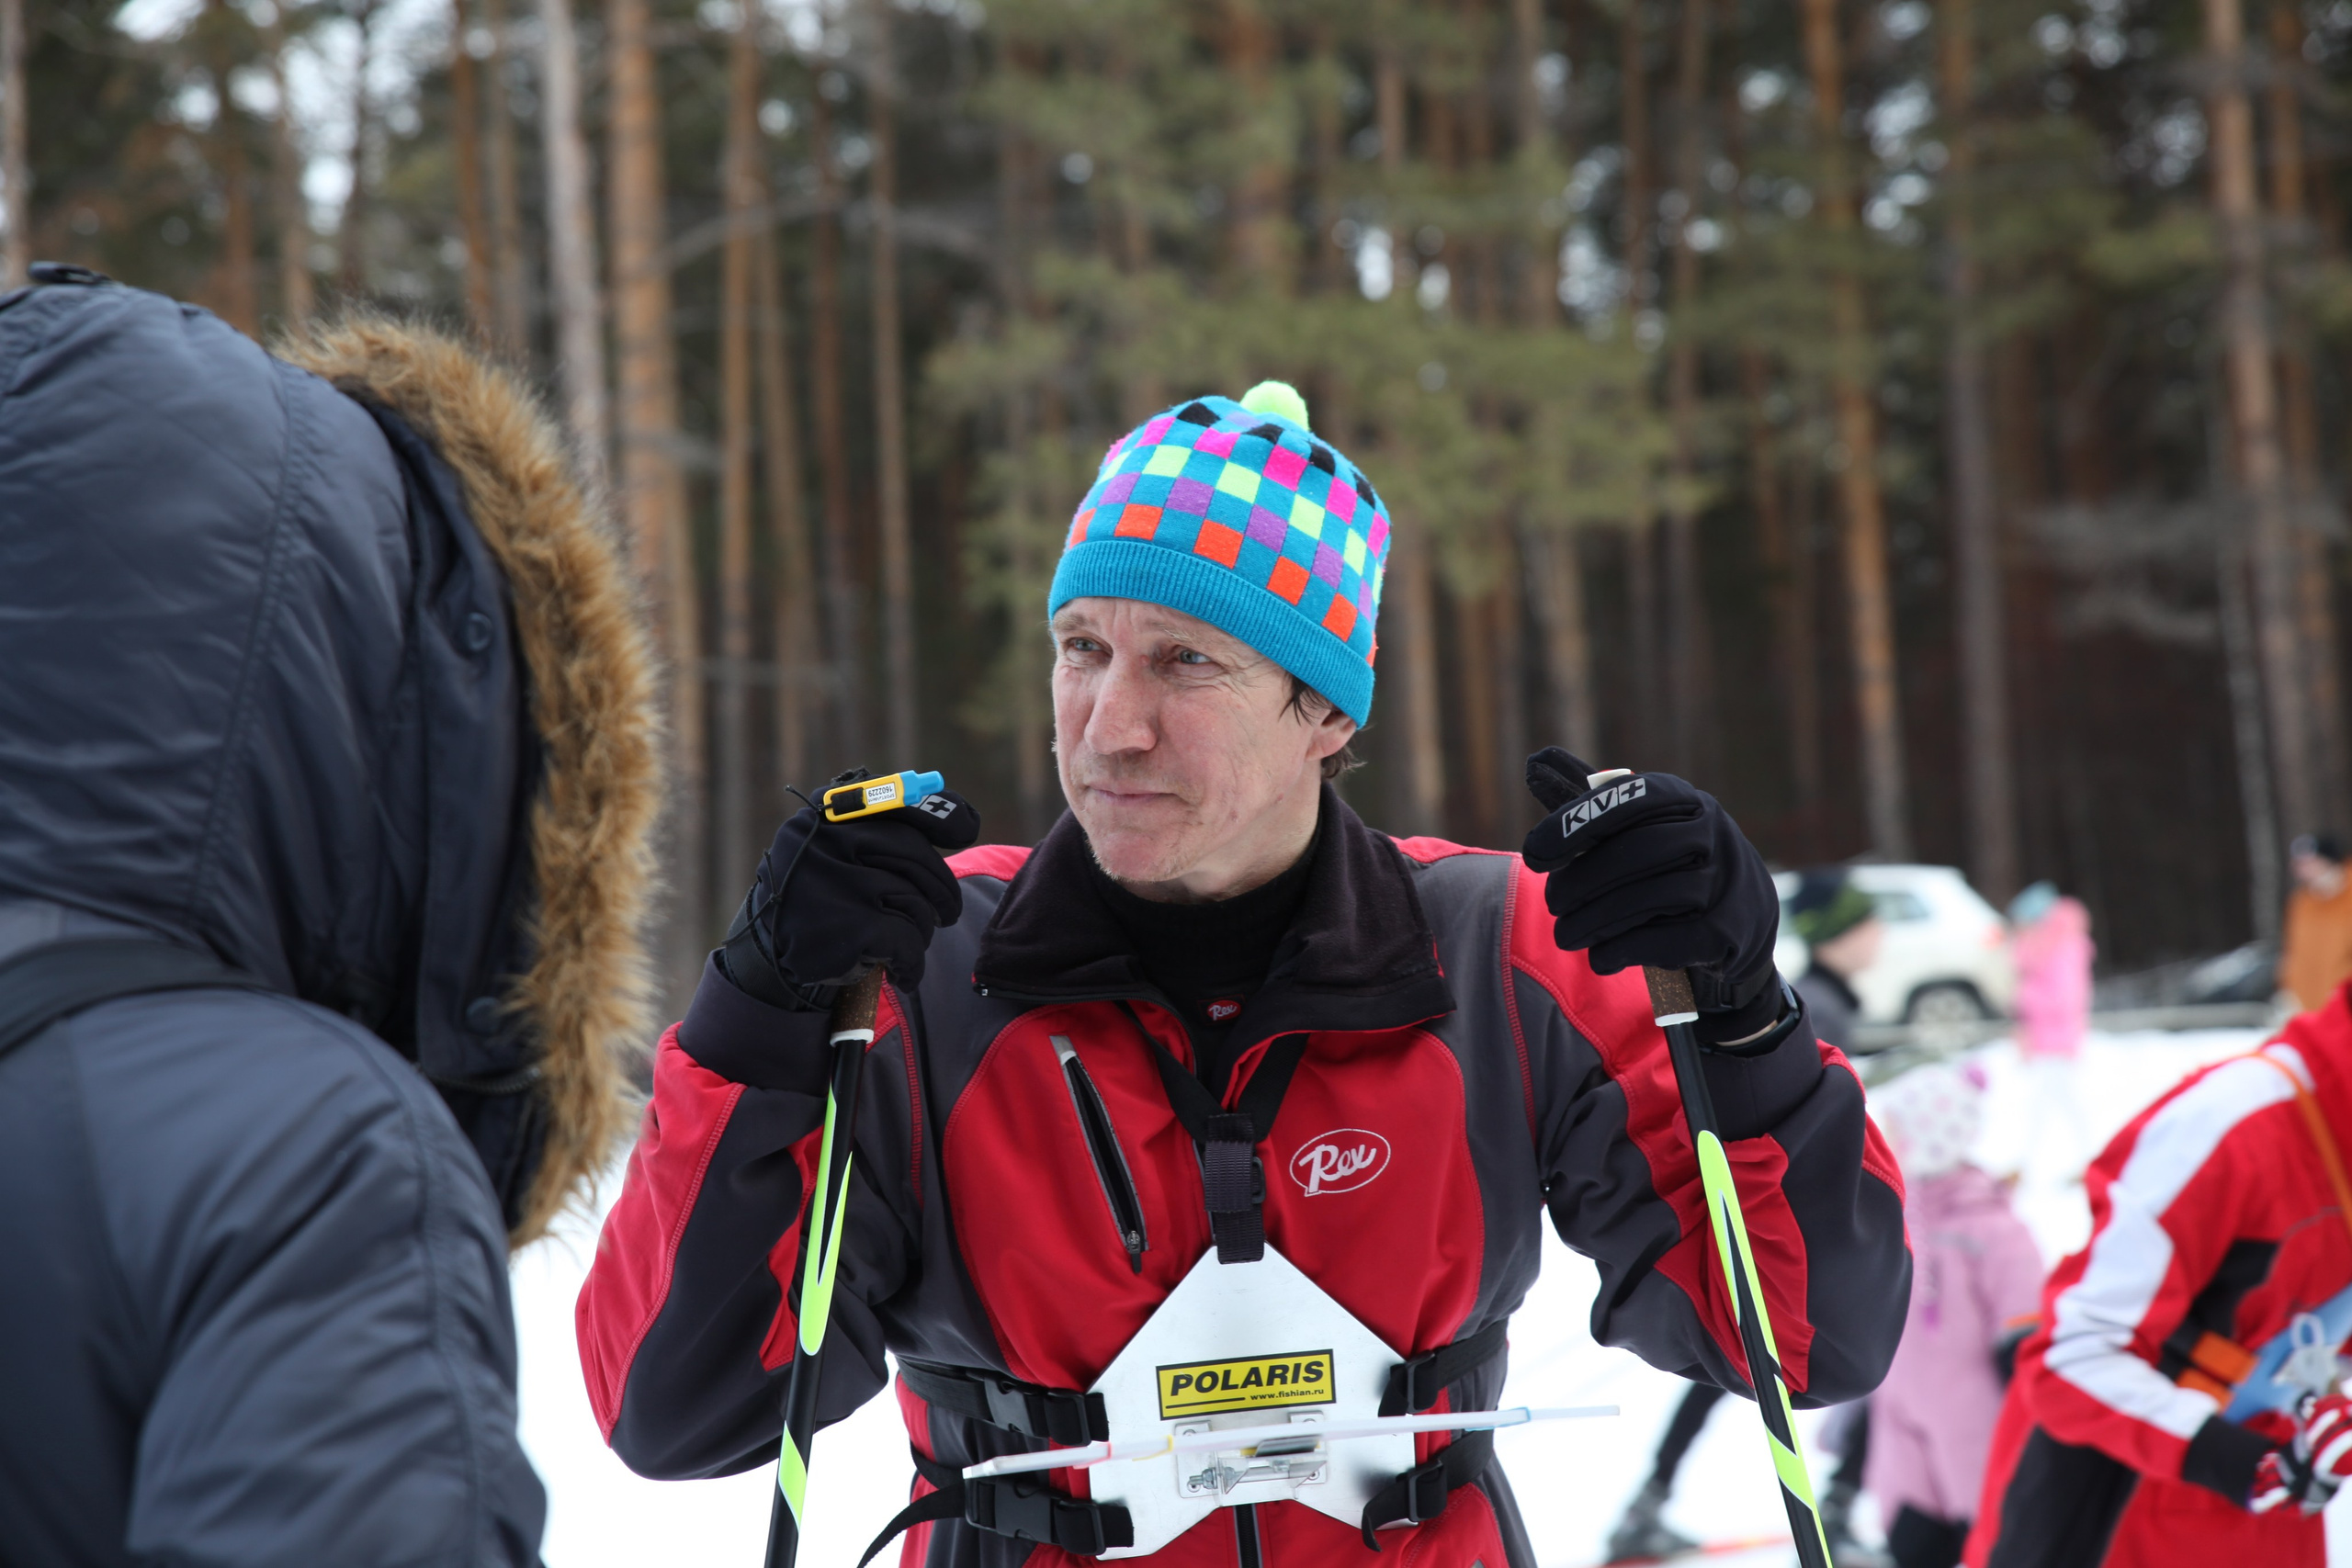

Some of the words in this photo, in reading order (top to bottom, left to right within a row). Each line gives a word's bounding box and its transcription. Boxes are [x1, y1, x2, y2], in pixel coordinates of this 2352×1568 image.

[868, 785, 892, 797] 1602229
[1208, 1004, 1238, 1021] Rex
[1298, 1144, 1377, 1193] Rex
[1170, 1360, 1325, 1396] POLARIS
[1250, 1388, 1325, 1401] www.fishian.ru
